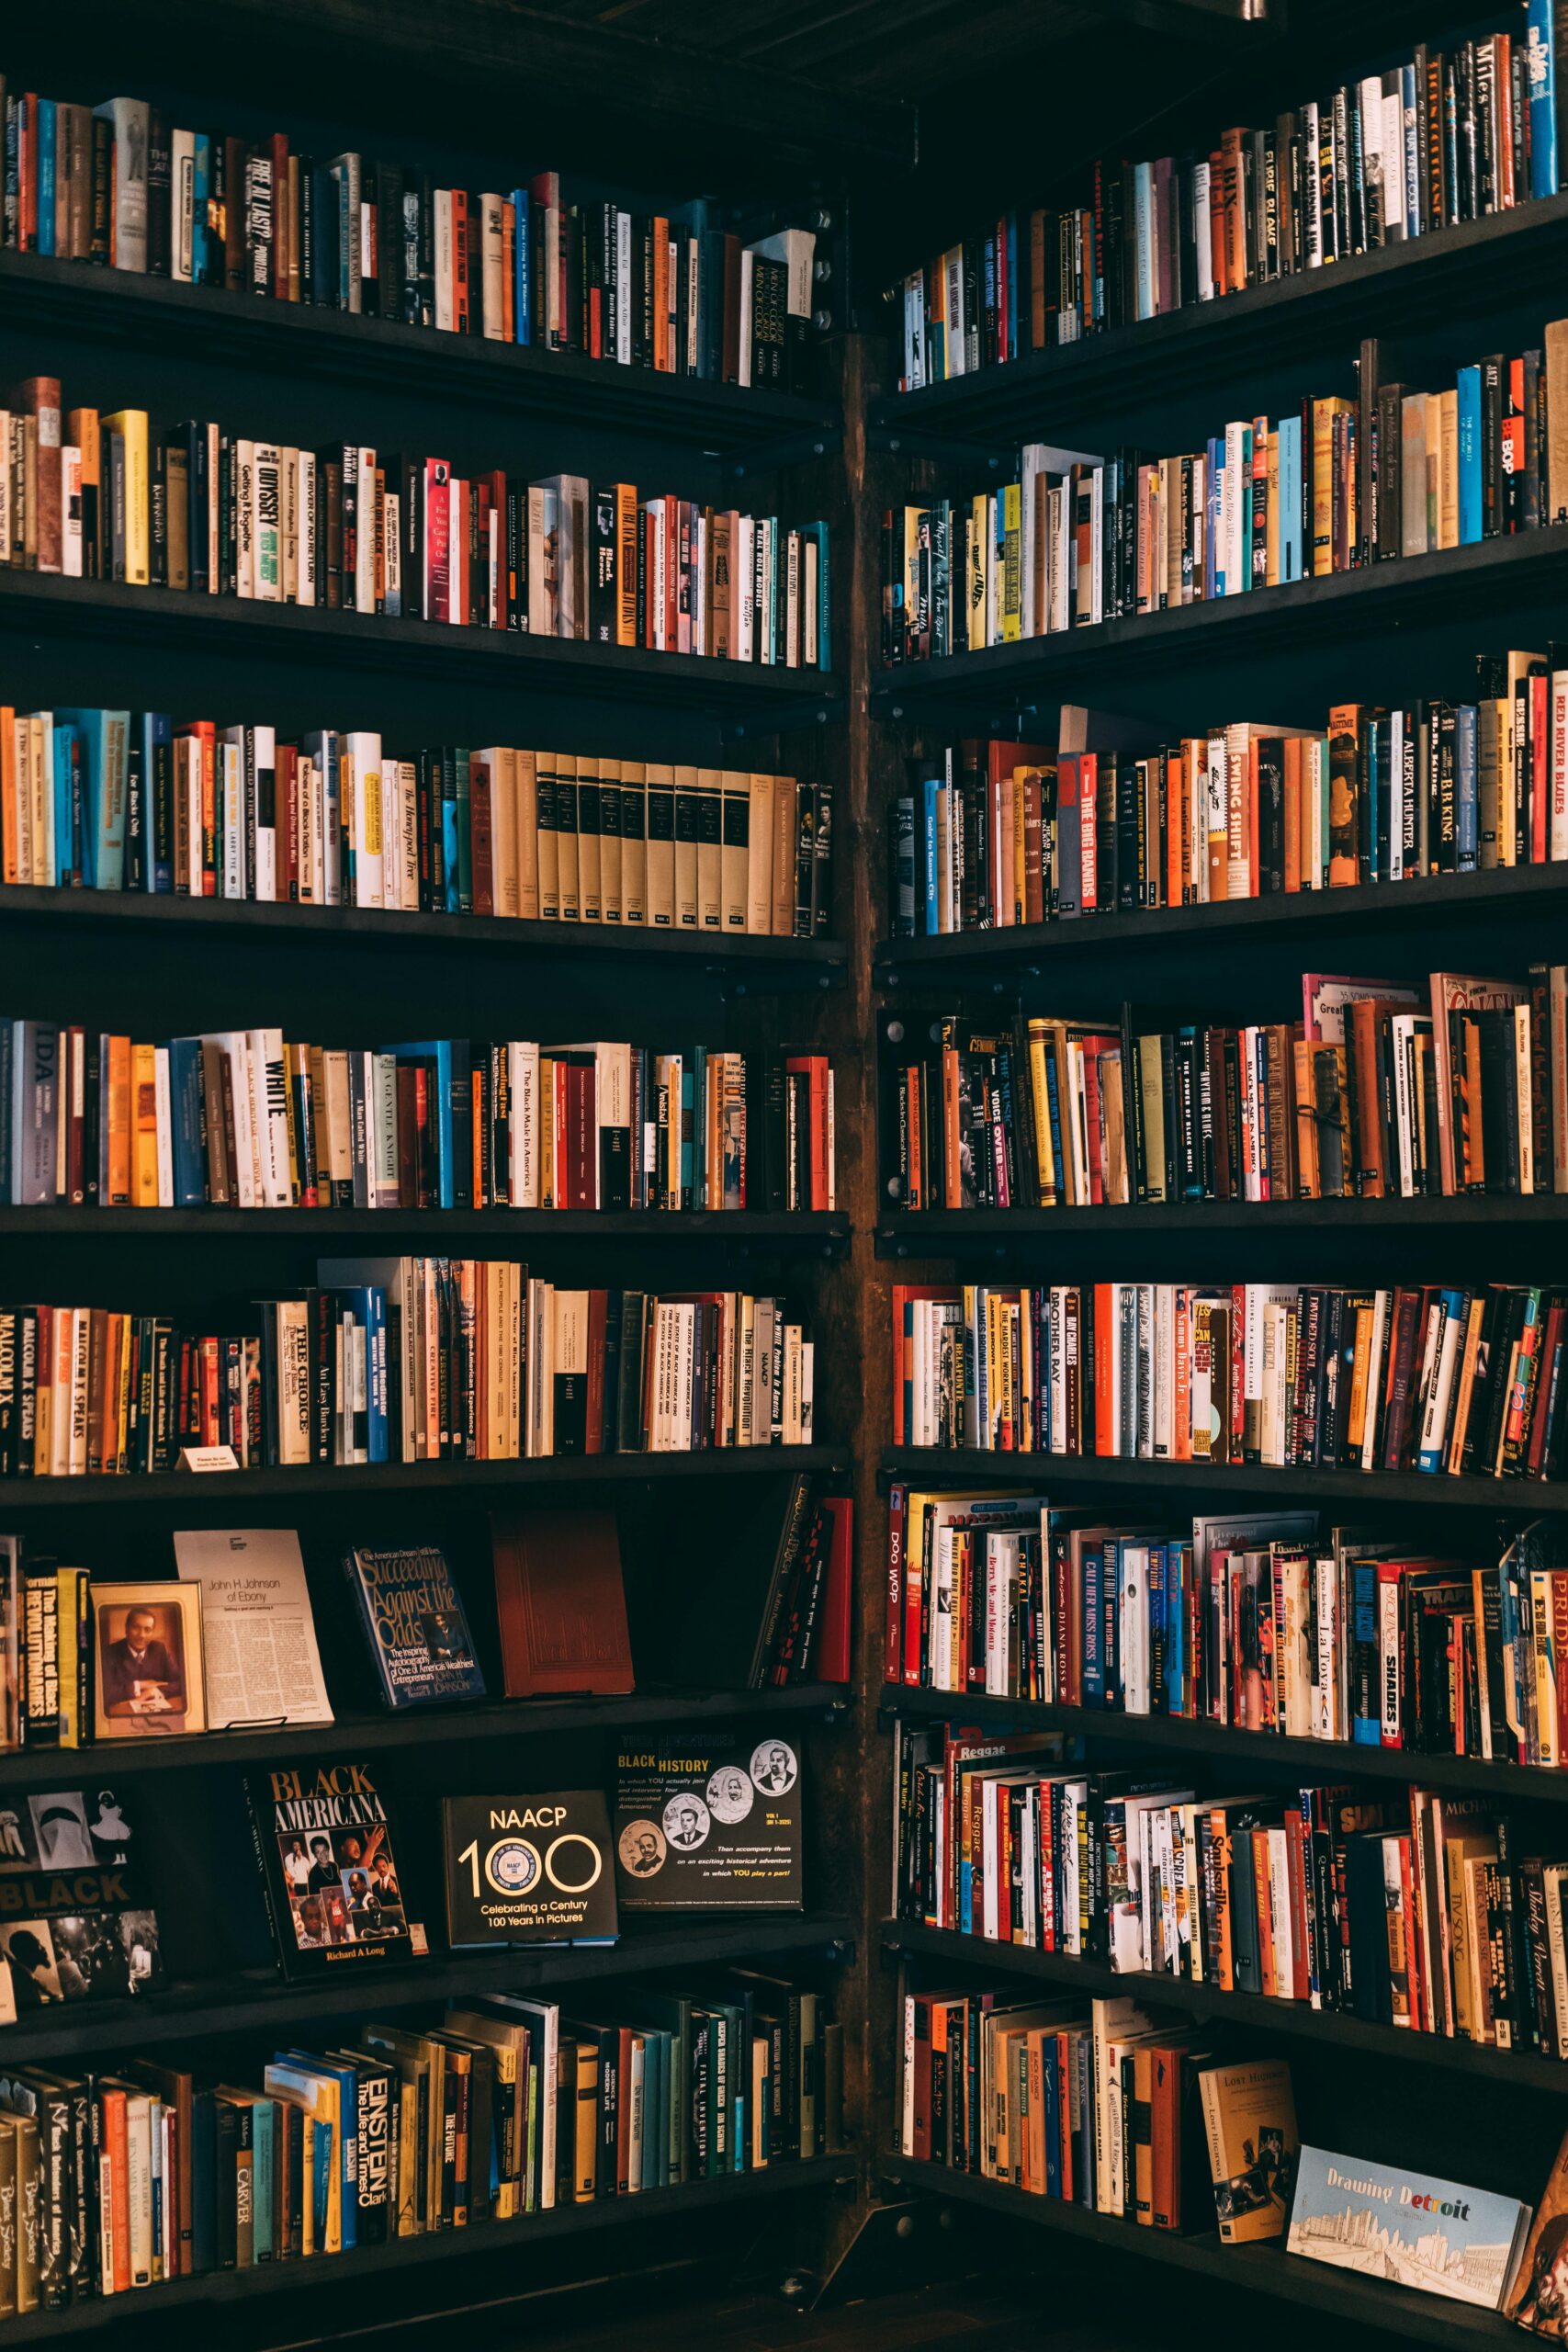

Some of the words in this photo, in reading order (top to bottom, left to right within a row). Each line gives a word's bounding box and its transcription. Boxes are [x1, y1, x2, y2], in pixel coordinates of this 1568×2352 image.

[1475, 44, 1495, 105] Miles
[252, 158, 272, 184] FREE
[252, 186, 271, 200] AT
[252, 202, 271, 238] LAST?
[254, 244, 268, 284] POWLEDGE
[240, 465, 251, 500] Getting
[259, 468, 278, 527] ODYSSEY
[240, 510, 251, 552] Together
[376, 509, 383, 521] ON
[1555, 695, 1565, 723] RED
[1555, 728, 1565, 766] RIVER
[1230, 754, 1242, 808] SWING
[1403, 741, 1415, 797] ALBERTA
[130, 791, 139, 816] Blacks
[405, 788, 413, 802] The
[1081, 796, 1094, 822] THE
[1555, 772, 1565, 815] BLUES
[129, 819, 139, 837] Only
[403, 805, 415, 856] Honey-pod
[1081, 823, 1094, 848] BIG
[1230, 812, 1242, 860] SHIFT
[1404, 799, 1415, 849] HUNTER
[407, 861, 416, 880] Tree
[1082, 850, 1095, 898] BANDS
[266, 1060, 286, 1119] WHITE
[991, 1090, 1001, 1124] VOICE
[525, 1138, 531, 1148] In
[994, 1125, 1003, 1164] OVER
[23, 1318, 34, 1378] MALCOLM
[296, 1325, 307, 1364] THE
[773, 1349, 782, 1375] Problem
[22, 1381, 34, 1390] X
[320, 1365, 329, 1382] An
[298, 1366, 309, 1435] CHOICE:
[317, 1384, 330, 1405] Easy
[773, 1389, 781, 1419] America
[1232, 1389, 1240, 1418] Franklin
[22, 1395, 33, 1440] SPEAKS
[320, 1408, 331, 1442] Burden
[890, 1532, 899, 1564] DOO
[358, 1548, 448, 1588] Succeeding
[888, 1569, 898, 1602] WOP
[43, 1589, 56, 1612] The
[227, 1593, 237, 1602] of
[239, 1592, 266, 1602] Ebony
[373, 1583, 434, 1623] Against
[432, 1581, 456, 1610] the
[43, 1615, 57, 1662] Making
[377, 1611, 424, 1649] Odds
[27, 1589, 44, 1718] REVOLUTIONARIES
[44, 1665, 57, 1678] of
[45, 1679, 59, 1715] Black
[1386, 1656, 1396, 1723] SHADES
[618, 1755, 656, 1768] BLACK
[659, 1759, 709, 1771] HISTORY
[268, 1764, 377, 1802] BLACK
[275, 1793, 388, 1833] AMERICANA
[490, 1807, 568, 1829] NAACP
[962, 1785, 971, 1825] Reggae
[972, 1806, 983, 1852] Reggae
[457, 1834, 602, 1898] 100
[0, 1873, 131, 1910] BLACK
[481, 1903, 538, 1915] Celebrating
[549, 1900, 588, 1910] Century
[1451, 1893, 1462, 1916] TIV
[1528, 1882, 1545, 1935] Shirley
[488, 1917, 506, 1928] 100
[508, 1917, 534, 1926] Years
[547, 1914, 582, 1923] Pictures
[326, 1951, 356, 1962] Richard
[366, 1947, 385, 1956] Long
[1453, 1917, 1464, 1961] SONG
[1533, 1942, 1546, 1992] Verrett
[358, 2082, 370, 2105] The
[358, 2106, 370, 2130] Life
[368, 2077, 388, 2191] EINSTEIN
[446, 2113, 456, 2130] THE
[358, 2132, 369, 2154] and
[445, 2131, 455, 2164] FUTURE
[358, 2157, 369, 2192] Times
[237, 2168, 249, 2225] CARVER
[358, 2193, 388, 2208] Clark
[1327, 2167, 1395, 2204] Drawing
[1399, 2186, 1471, 2222] Detroit
